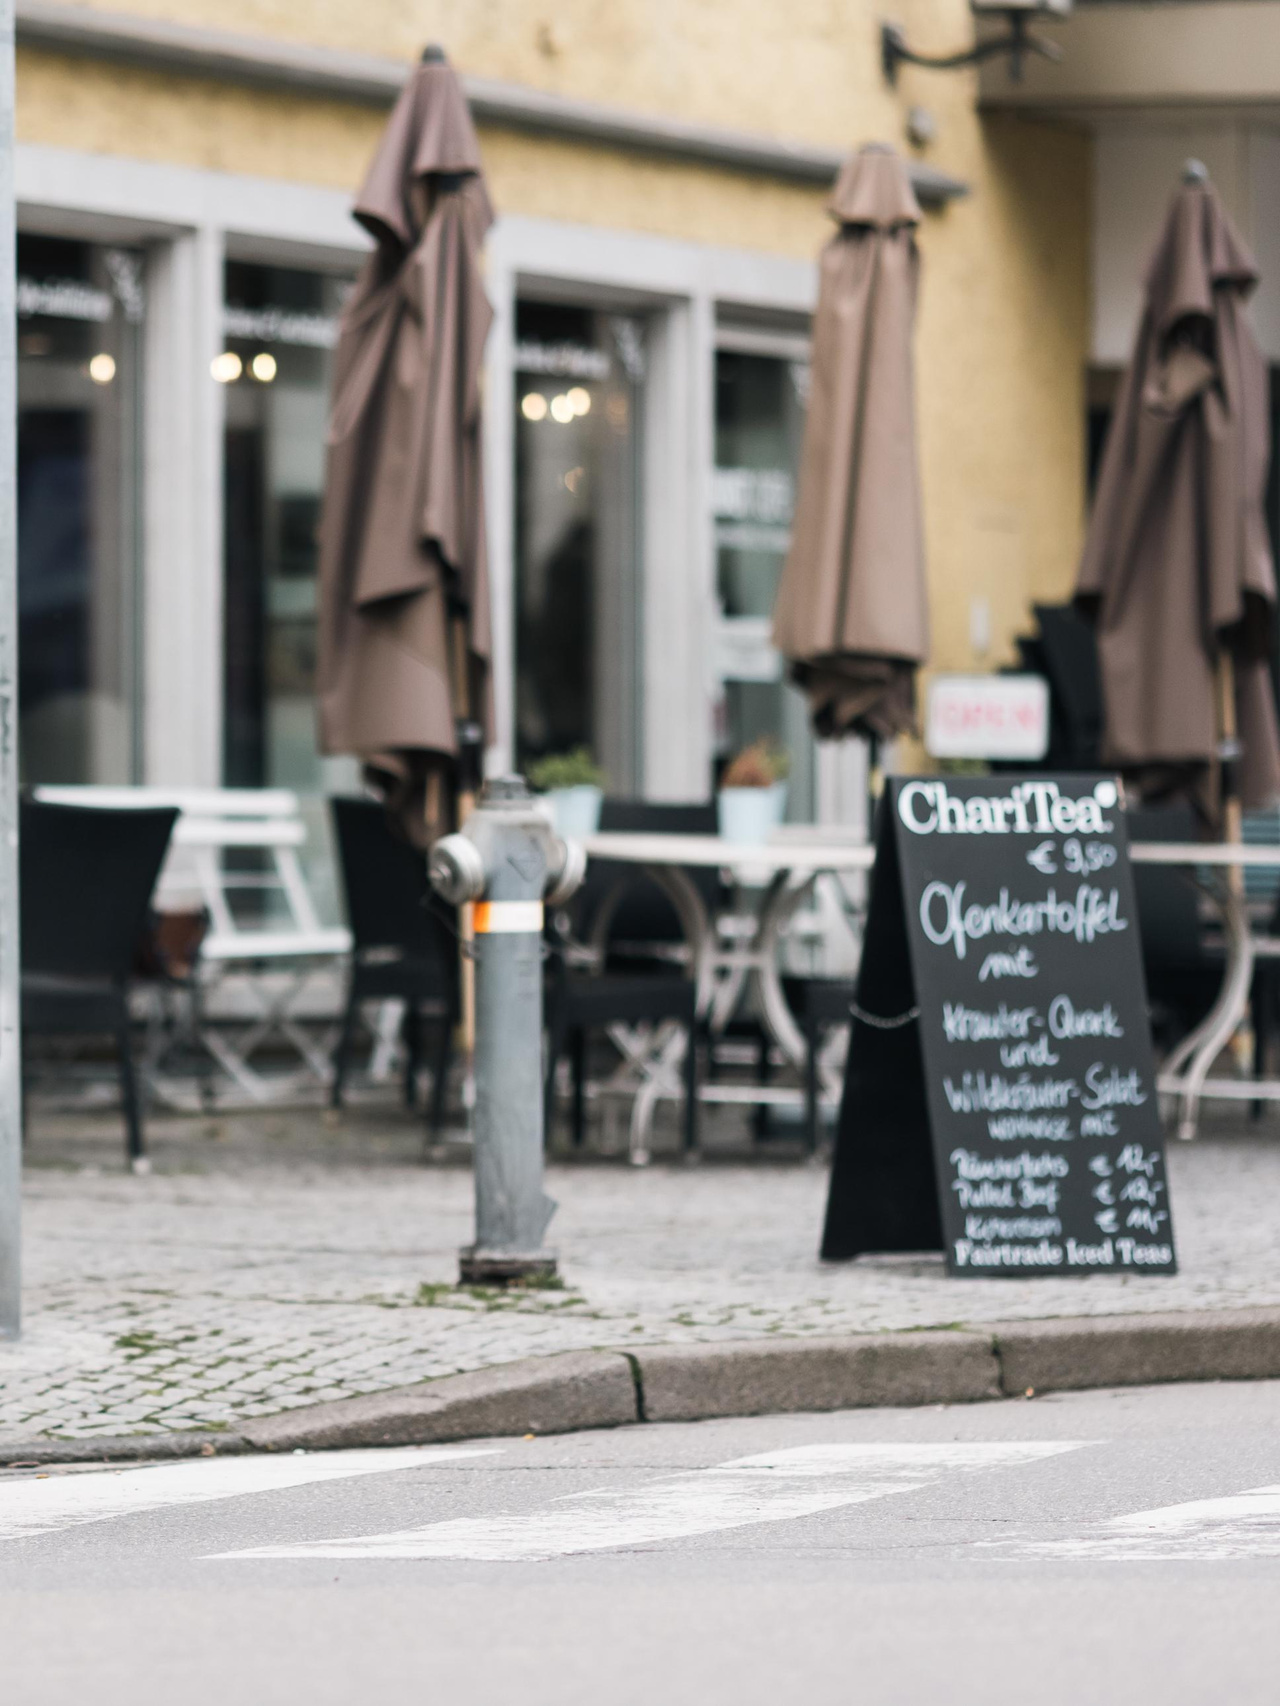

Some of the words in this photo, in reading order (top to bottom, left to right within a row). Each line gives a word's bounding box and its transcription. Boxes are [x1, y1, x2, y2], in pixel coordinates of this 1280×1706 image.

[898, 781, 1116, 834] ChariTea
[1026, 840, 1058, 874] €
[920, 880, 1129, 960] Ofenkartoffel
[978, 945, 1040, 981] mit
[1000, 1034, 1060, 1068] und
[955, 1238, 1063, 1266] Fairtrade
[1066, 1237, 1115, 1266] Iced
[1116, 1237, 1172, 1266] Teas
